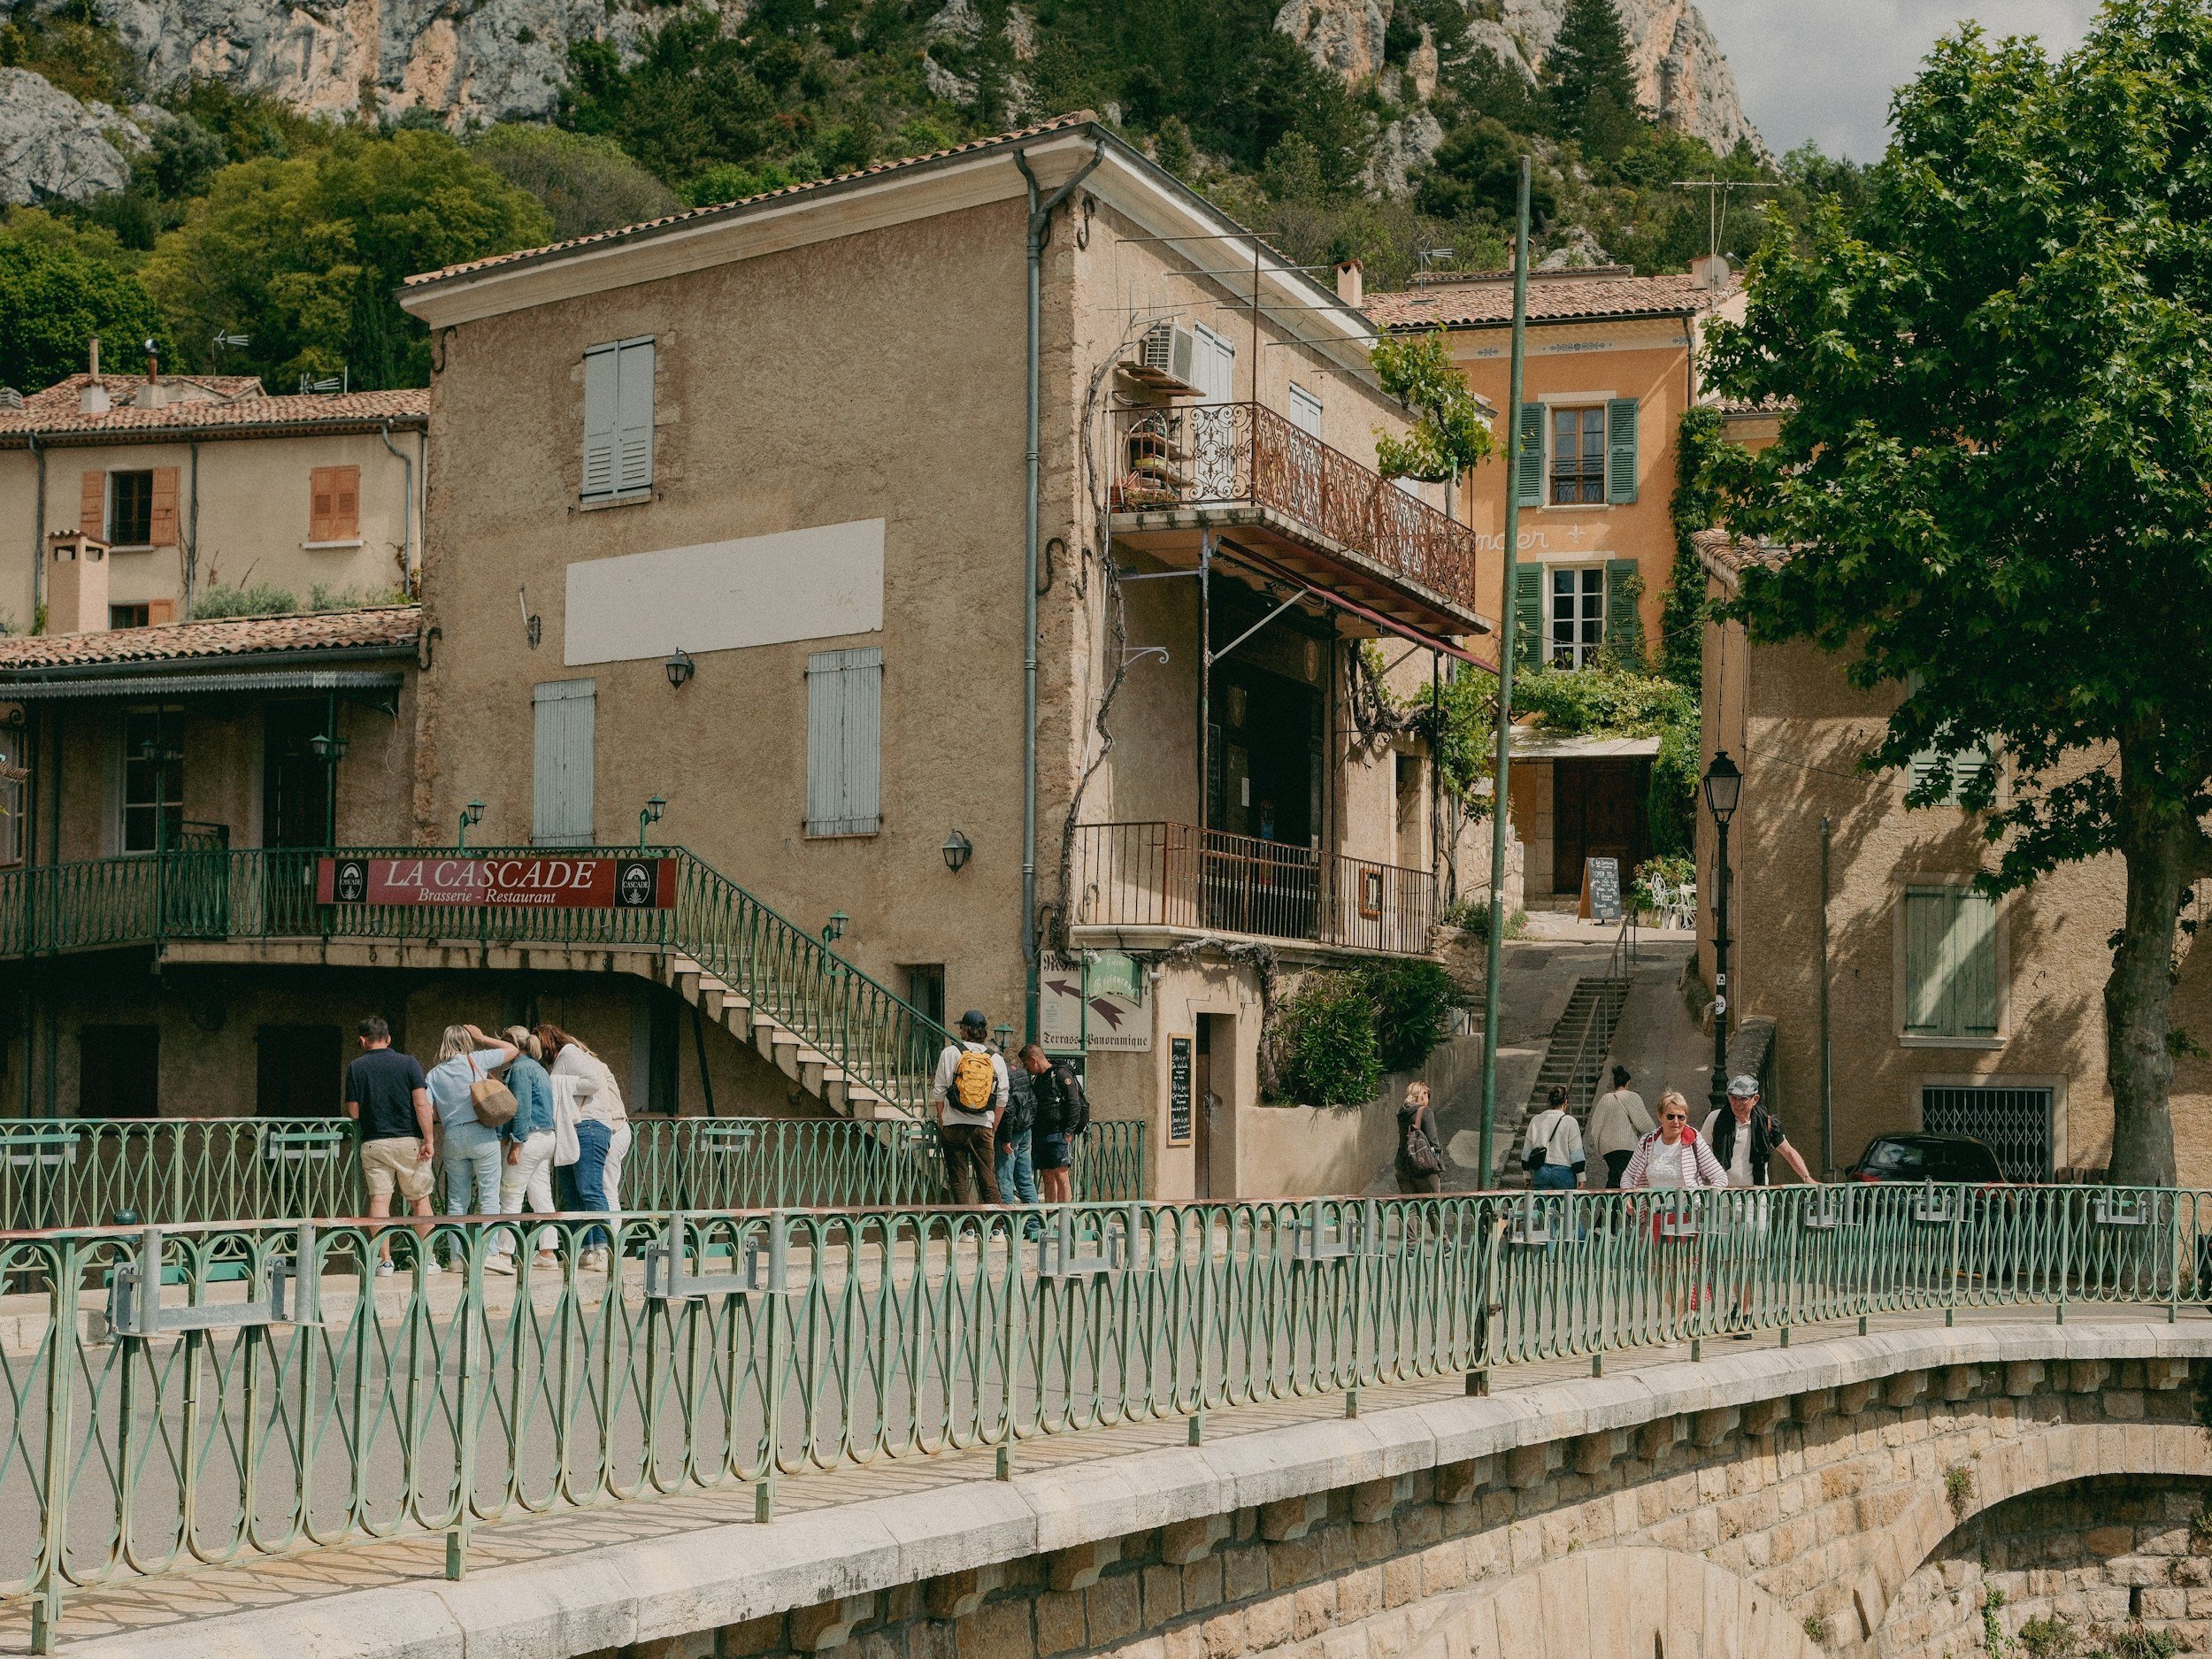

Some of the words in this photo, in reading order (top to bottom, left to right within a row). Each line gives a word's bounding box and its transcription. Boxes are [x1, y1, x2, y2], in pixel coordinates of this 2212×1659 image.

[384, 861, 423, 887] LA
[434, 860, 596, 888] CASCADE
[418, 887, 472, 902] Brasserie
[485, 888, 557, 903] Restaurant
[1043, 1032, 1081, 1044] Terrass
[1087, 1033, 1148, 1049] Panoramique
